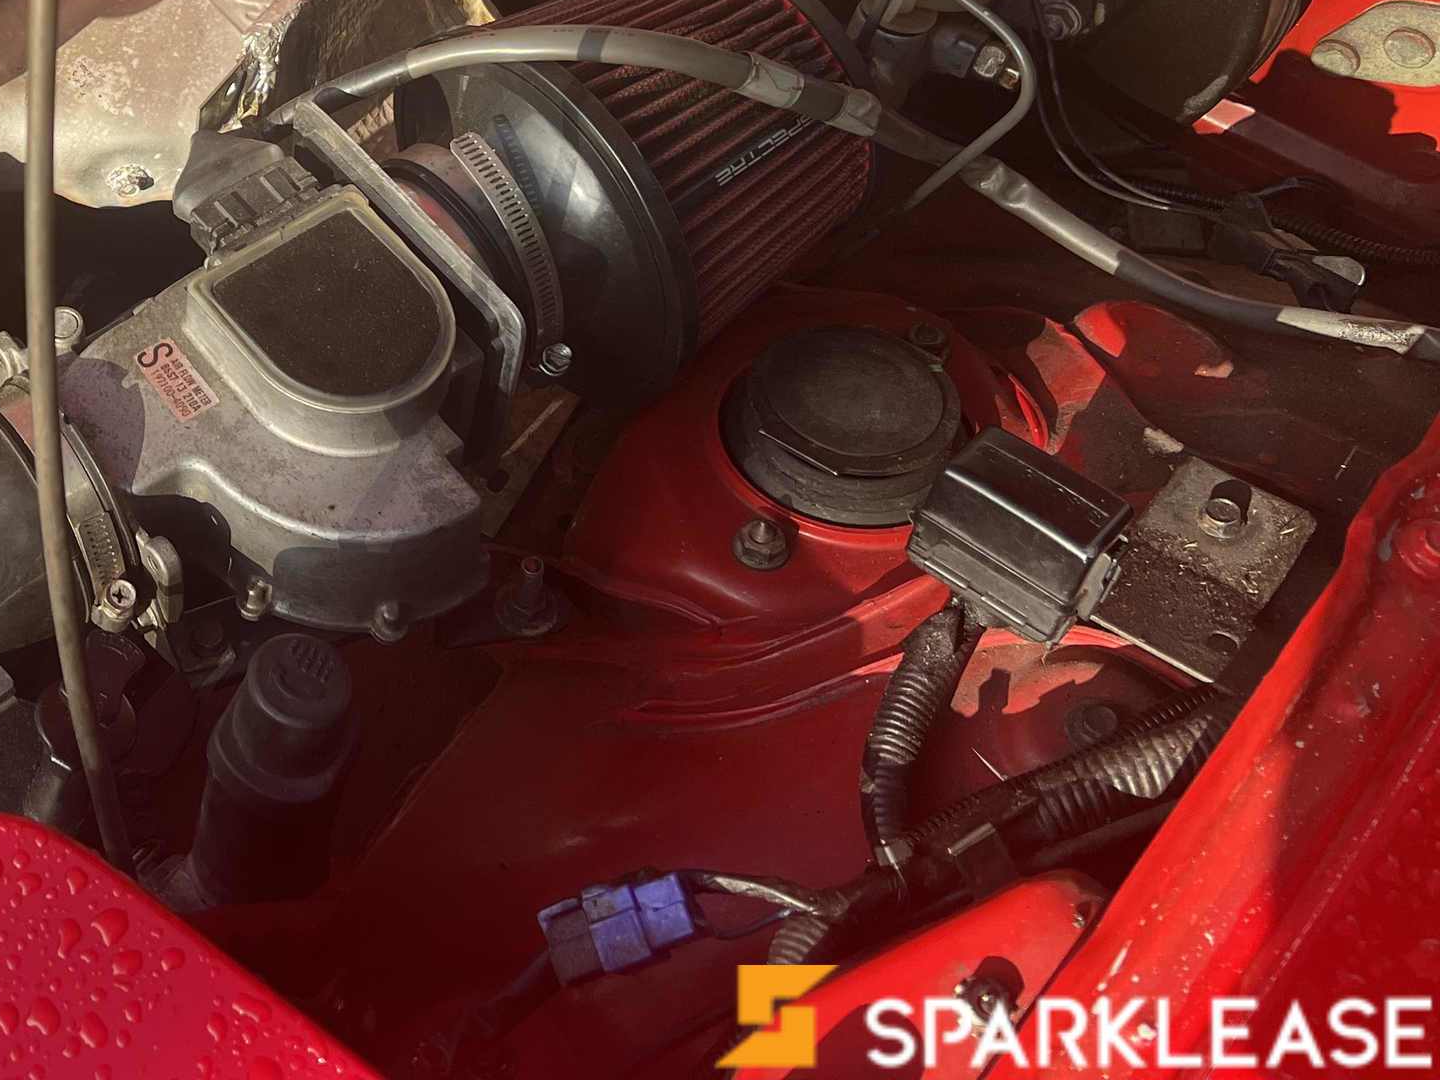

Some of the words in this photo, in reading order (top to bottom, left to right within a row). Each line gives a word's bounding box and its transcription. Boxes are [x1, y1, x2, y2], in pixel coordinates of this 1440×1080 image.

[137, 342, 173, 368] S
[171, 358, 184, 370] AIR
[178, 368, 196, 386] FLOW
[192, 385, 213, 406] METER
